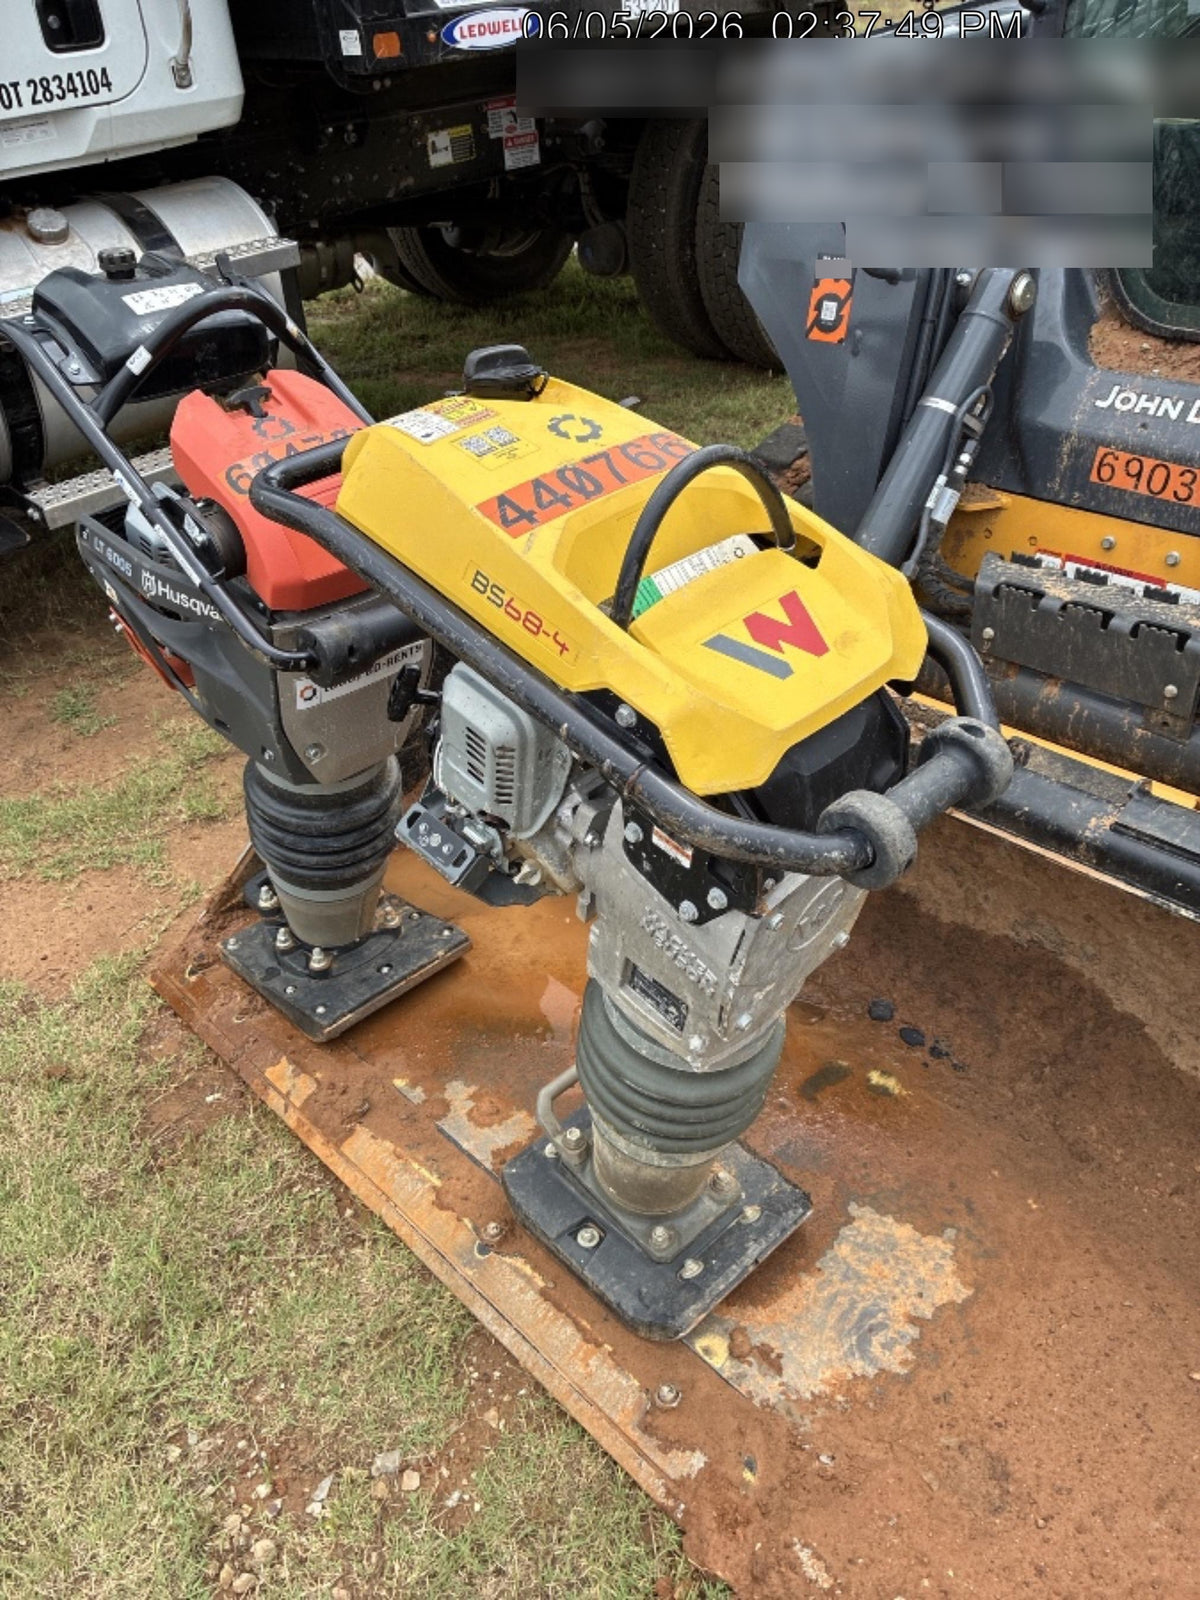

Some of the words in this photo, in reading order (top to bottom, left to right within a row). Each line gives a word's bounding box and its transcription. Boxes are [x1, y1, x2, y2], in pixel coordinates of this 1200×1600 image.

[26, 66, 113, 106] 2834104
[1095, 385, 1184, 421] JOHN
[496, 432, 696, 529] 440766
[1096, 451, 1198, 502] 6903
[157, 579, 224, 621] Husqva
[470, 569, 570, 656] BS68-4
